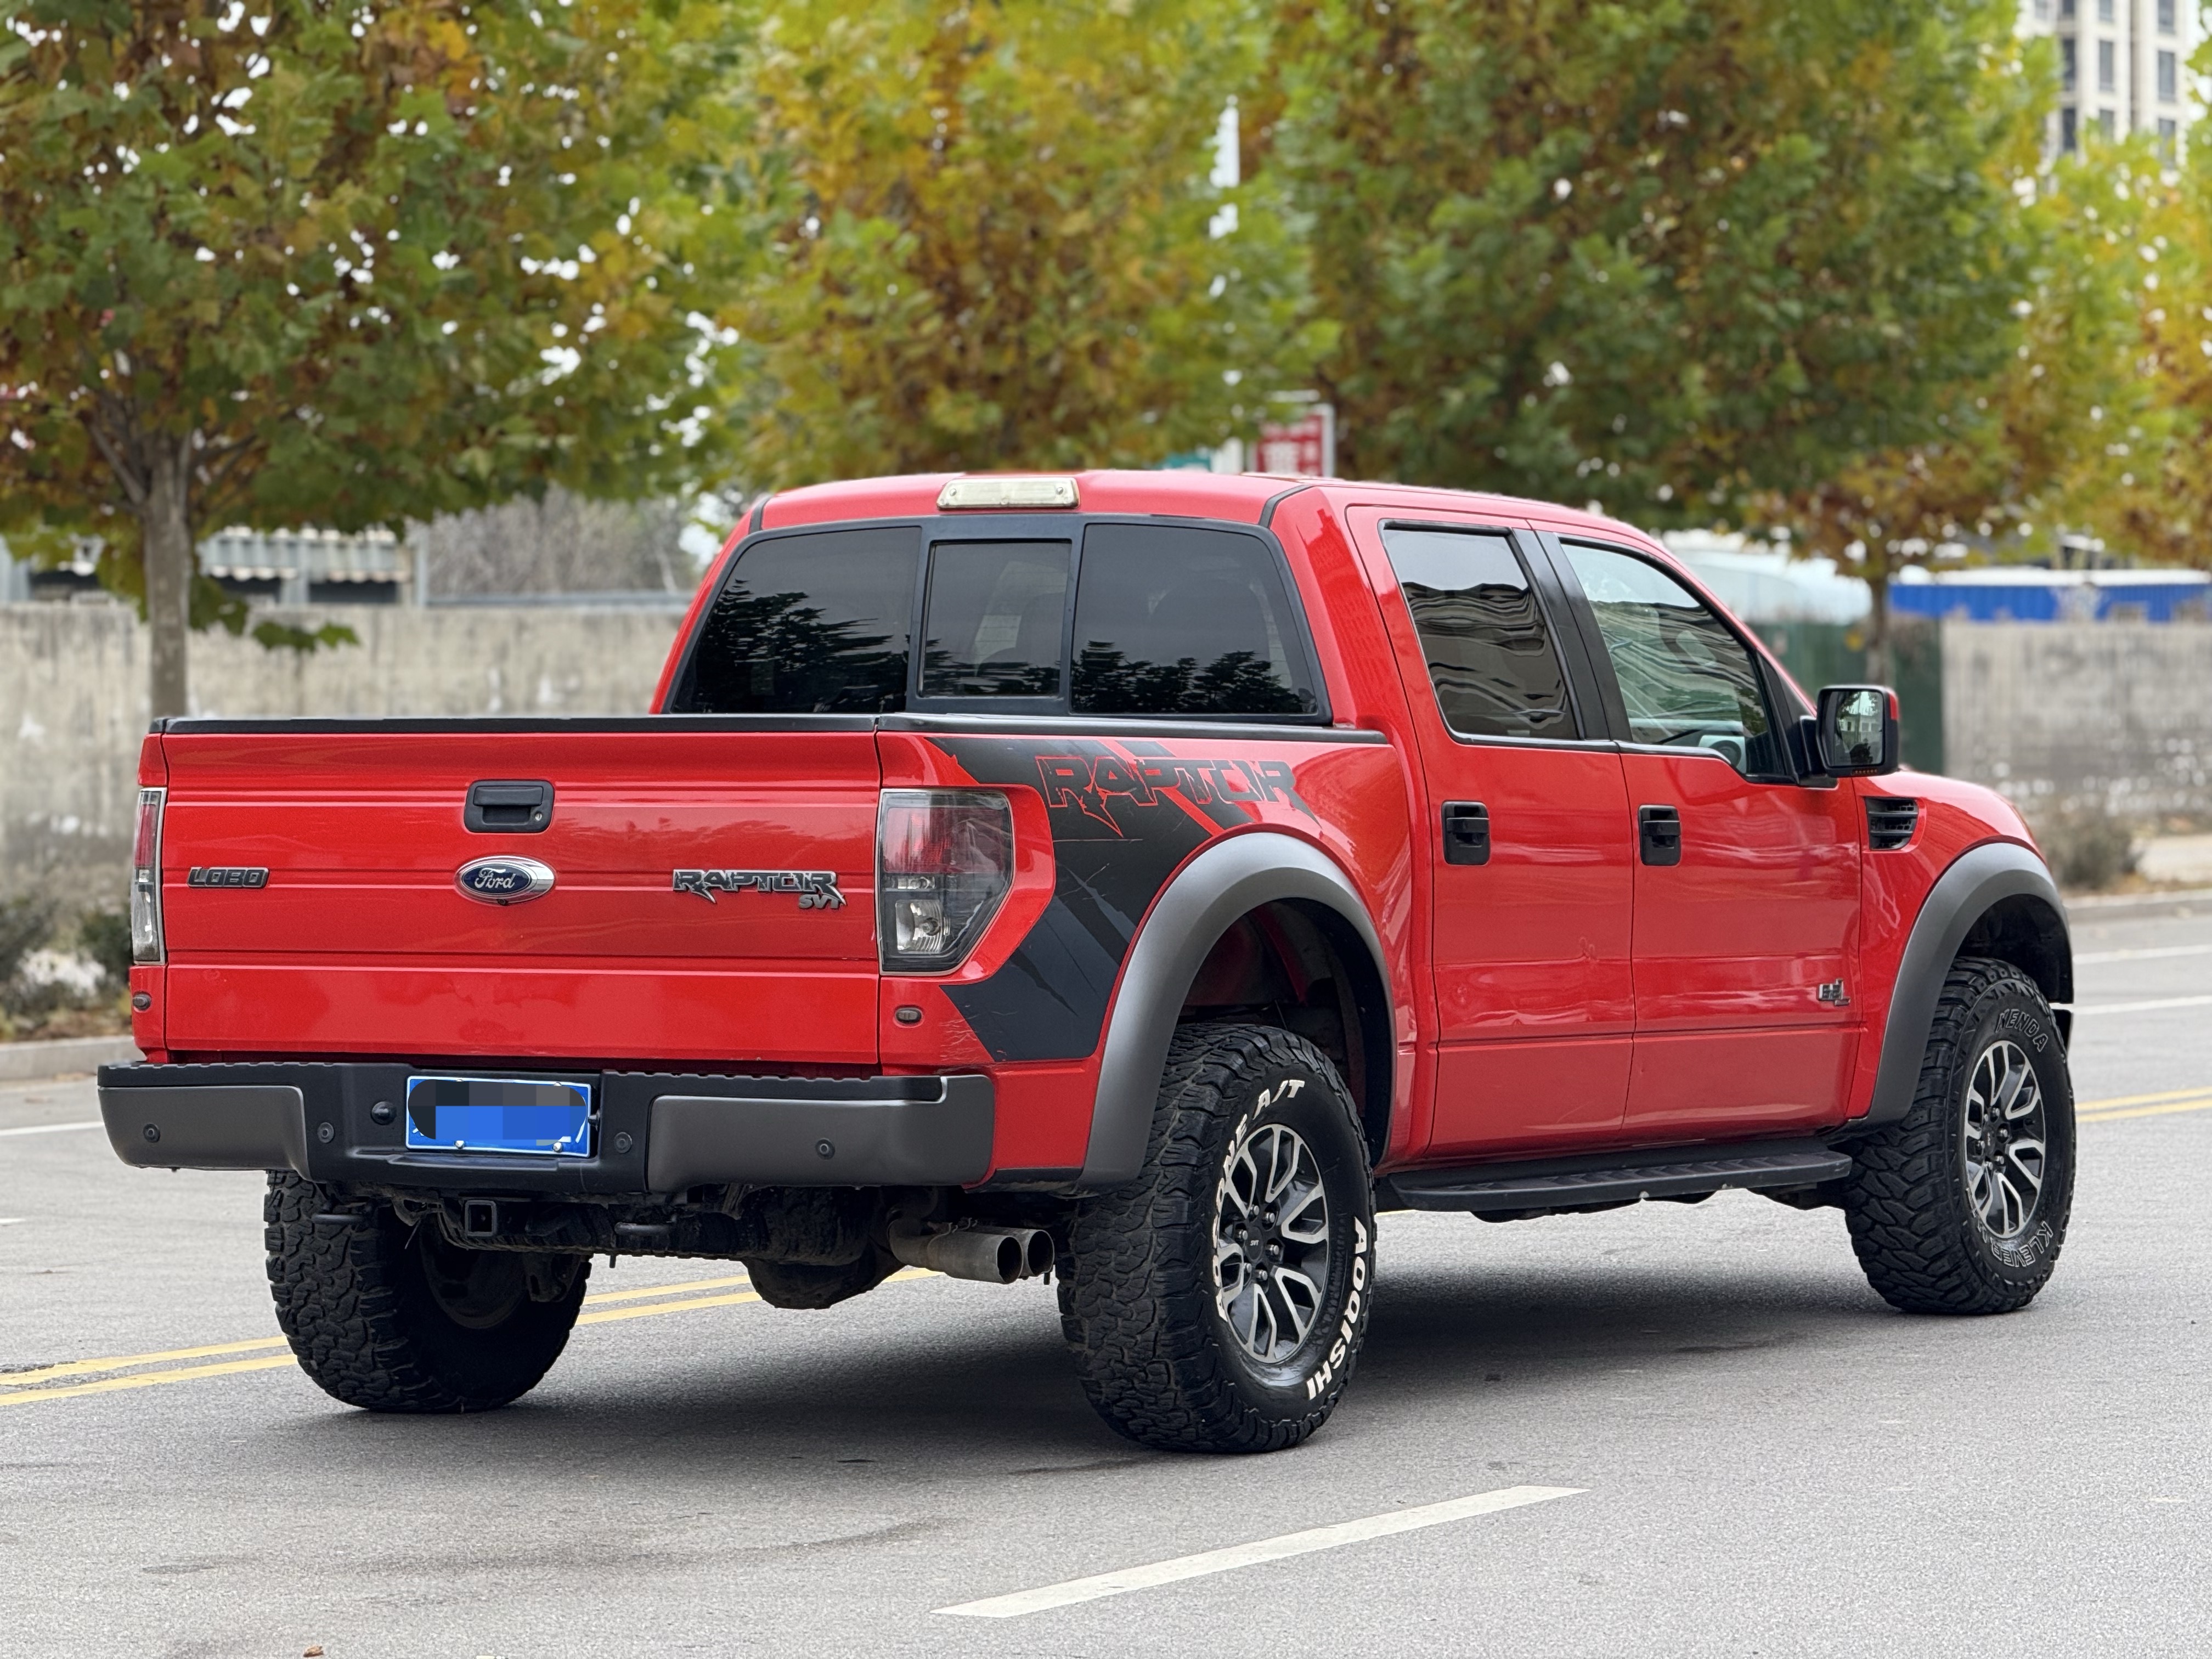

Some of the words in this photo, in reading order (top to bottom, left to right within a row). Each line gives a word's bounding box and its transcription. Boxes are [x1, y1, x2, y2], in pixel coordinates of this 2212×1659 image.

[1036, 755, 1322, 837] RAPTOR
[187, 867, 269, 888] LOBO
[475, 867, 516, 889] Ford
[673, 870, 847, 906] RAPTOR
[798, 895, 839, 909] SVT
[1995, 1008, 2049, 1053] KENDA
[1252, 1079, 1305, 1120] A/T
[1990, 1221, 2054, 1268] KLEVER
[1306, 1216, 1367, 1400] AOQISHI
